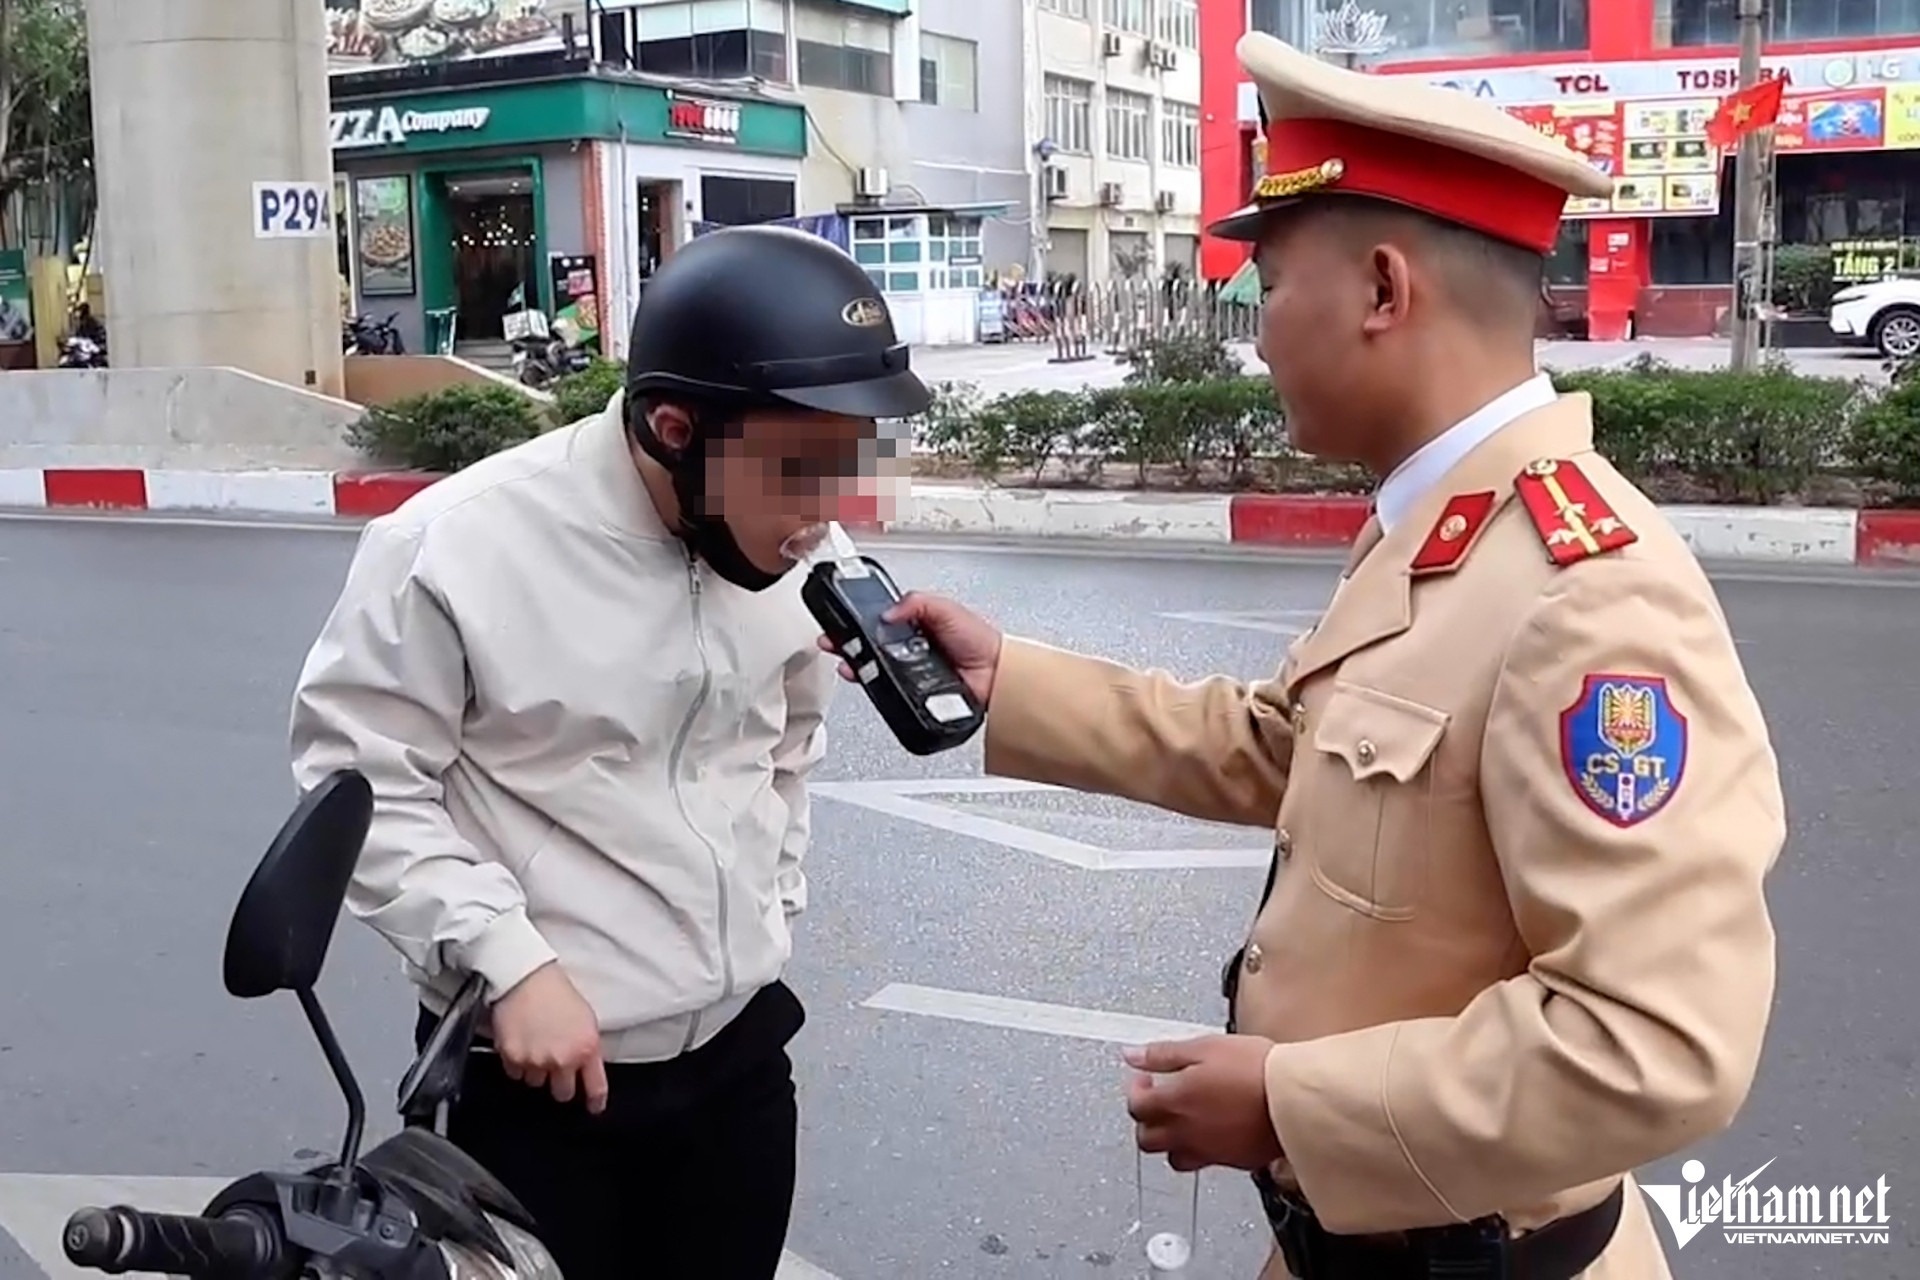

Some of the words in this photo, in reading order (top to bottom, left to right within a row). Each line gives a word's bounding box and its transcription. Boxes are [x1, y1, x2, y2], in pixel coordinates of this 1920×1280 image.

[1866, 58, 1900, 78] LG
[1555, 75, 1609, 93] TCL
[401, 107, 490, 132] Company
[1587, 753, 1620, 774] CS
[1634, 756, 1667, 778] GT
